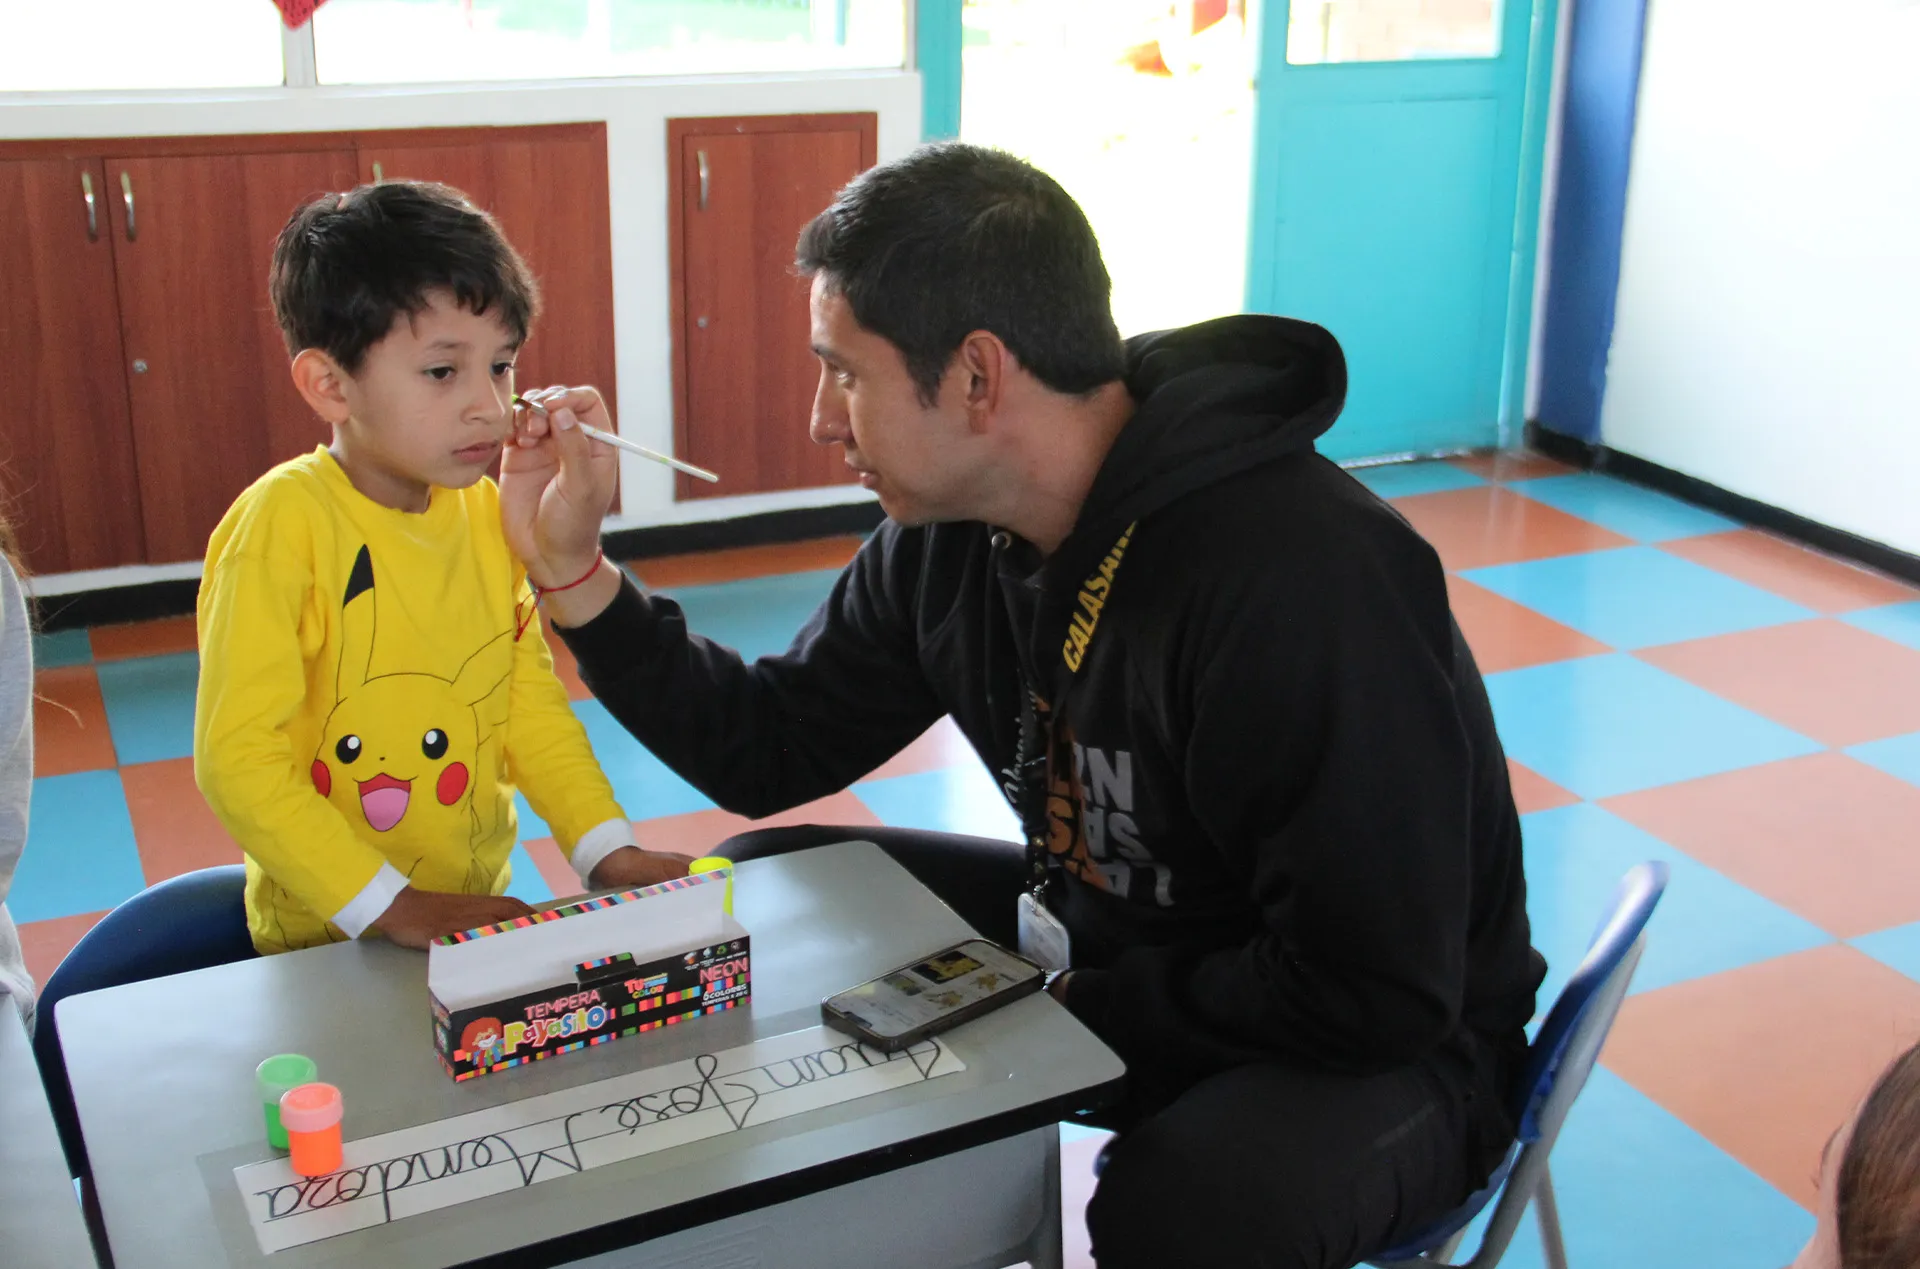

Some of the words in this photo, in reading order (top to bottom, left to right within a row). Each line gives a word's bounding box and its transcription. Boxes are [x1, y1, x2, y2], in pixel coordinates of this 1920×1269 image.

[624, 978, 645, 994] TU
[699, 957, 749, 984] NEON
[524, 988, 601, 1021] TEMPERA
[631, 984, 665, 999] COLOR
[502, 1006, 608, 1056] Payasito
[600, 1054, 759, 1134] José
[256, 1112, 584, 1223] Mendoza
